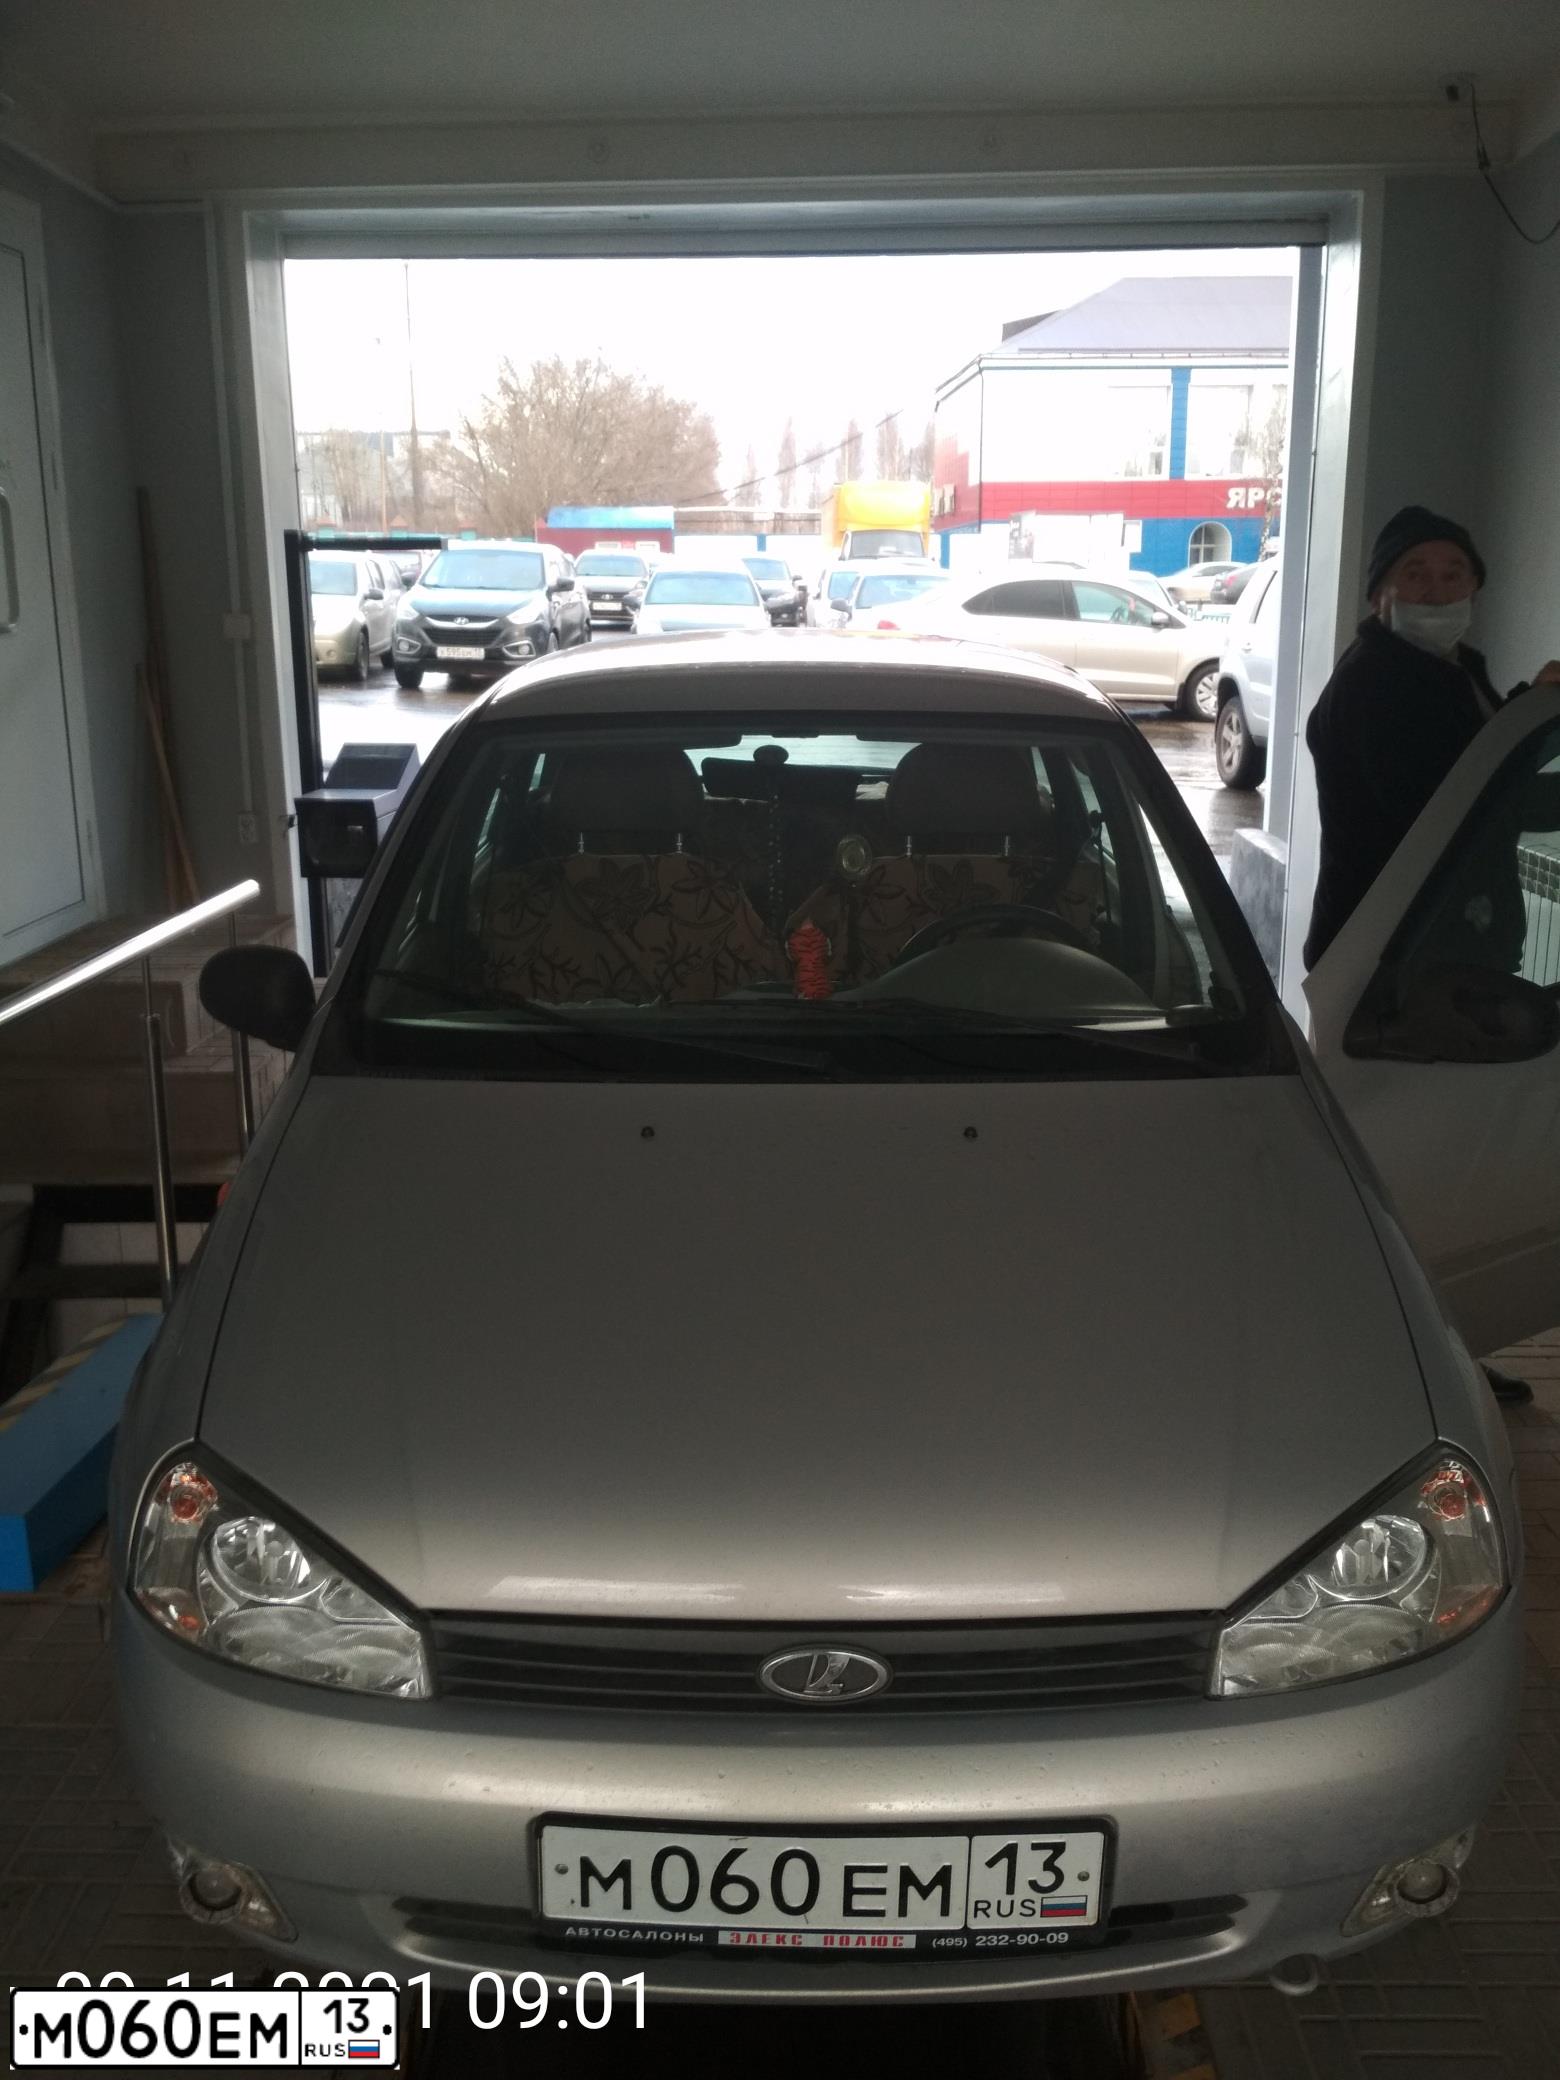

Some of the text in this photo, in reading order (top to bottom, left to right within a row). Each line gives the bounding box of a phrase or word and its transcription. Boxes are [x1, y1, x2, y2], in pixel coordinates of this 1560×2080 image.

[579, 1841, 1066, 1918] М060ЕМ 13
[973, 1899, 1037, 1919] RUS
[565, 1926, 1069, 1948] АВТОСАЛОНЫ ЭЛЕКС ПОЛЮС (495) 232-90-09
